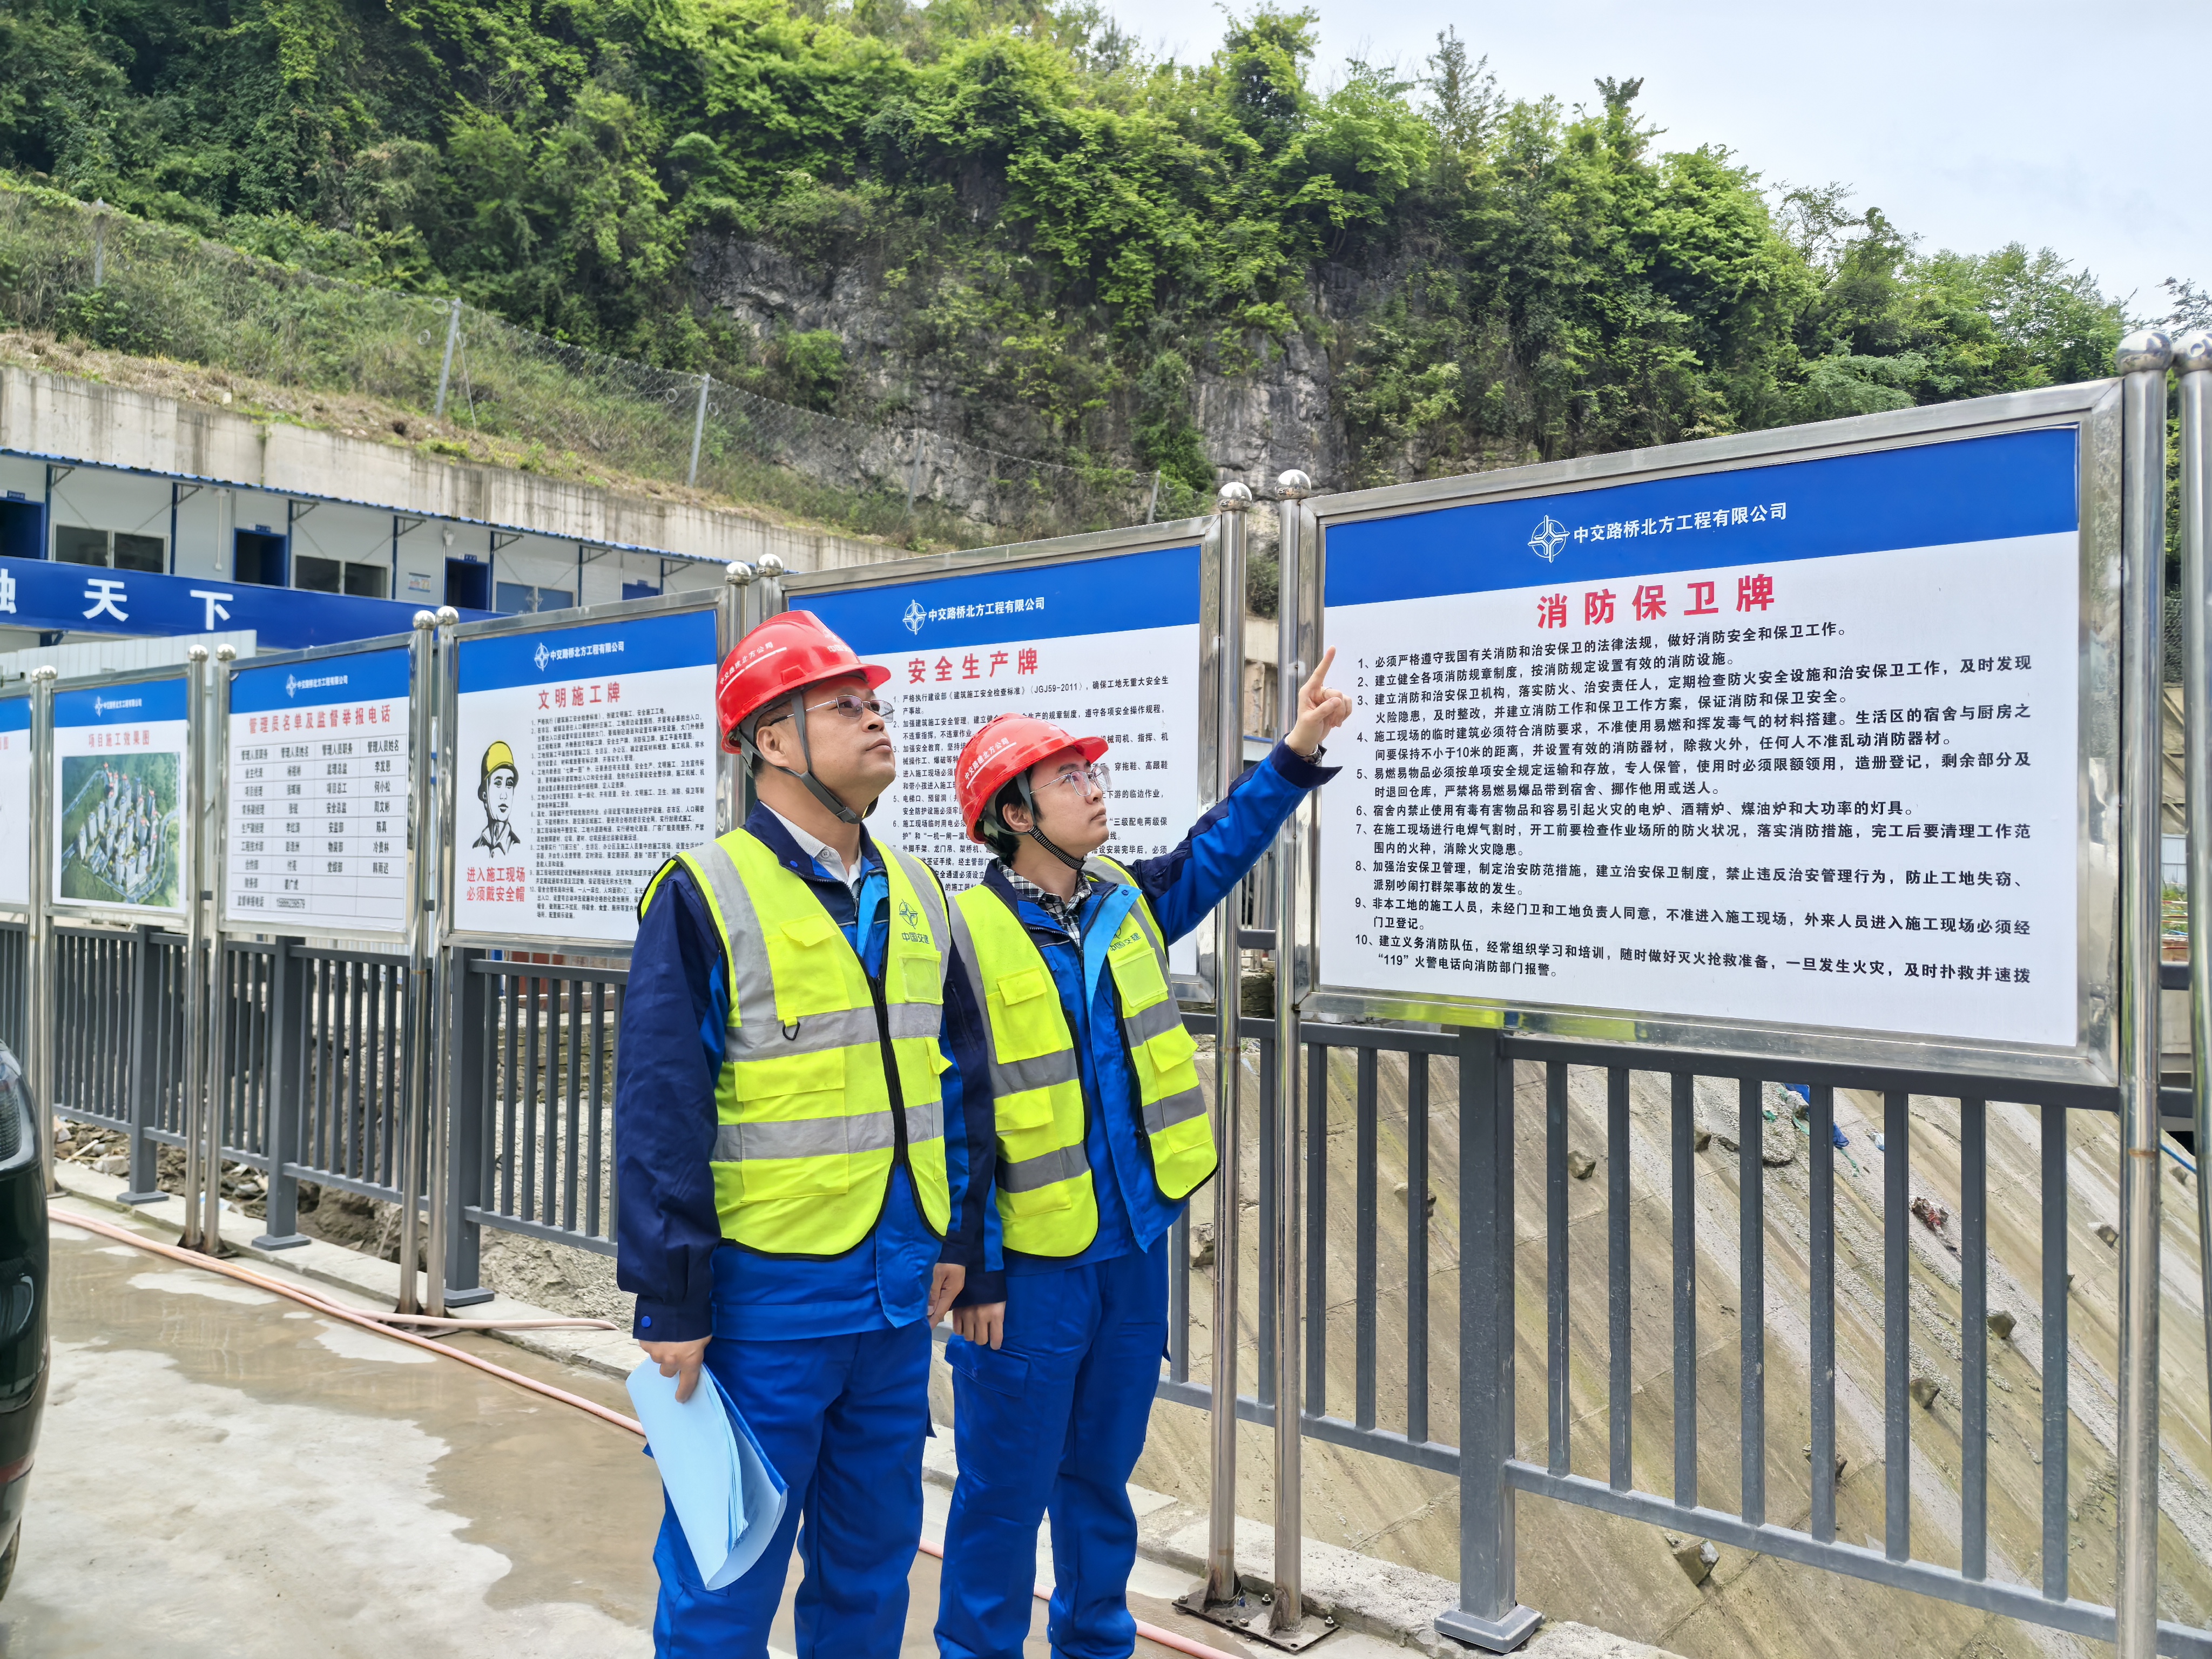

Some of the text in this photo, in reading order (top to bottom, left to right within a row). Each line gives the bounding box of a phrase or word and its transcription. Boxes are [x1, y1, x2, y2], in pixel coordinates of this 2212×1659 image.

[1573, 500, 1788, 546] 中交路桥北方工程有限公司
[928, 597, 1045, 622] 中交路桥北方工程有限公司
[1536, 572, 1777, 630] 消防保卫牌
[550, 641, 624, 662] 中交路桥北方工程有限公司
[908, 648, 1039, 684] 安全生产牌
[538, 682, 621, 710] 文明施工牌
[249, 704, 391, 734] 管理员名单及监督举报电话
[902, 706, 924, 716] 产事故。
[89, 730, 149, 747] 项目施工效果图
[902, 729, 974, 740] 不违章指挥，不违章作业
[367, 739, 399, 753] 管理人员姓名
[467, 866, 525, 882] 进入施工现场
[467, 887, 525, 903] 必须戴安全帽
